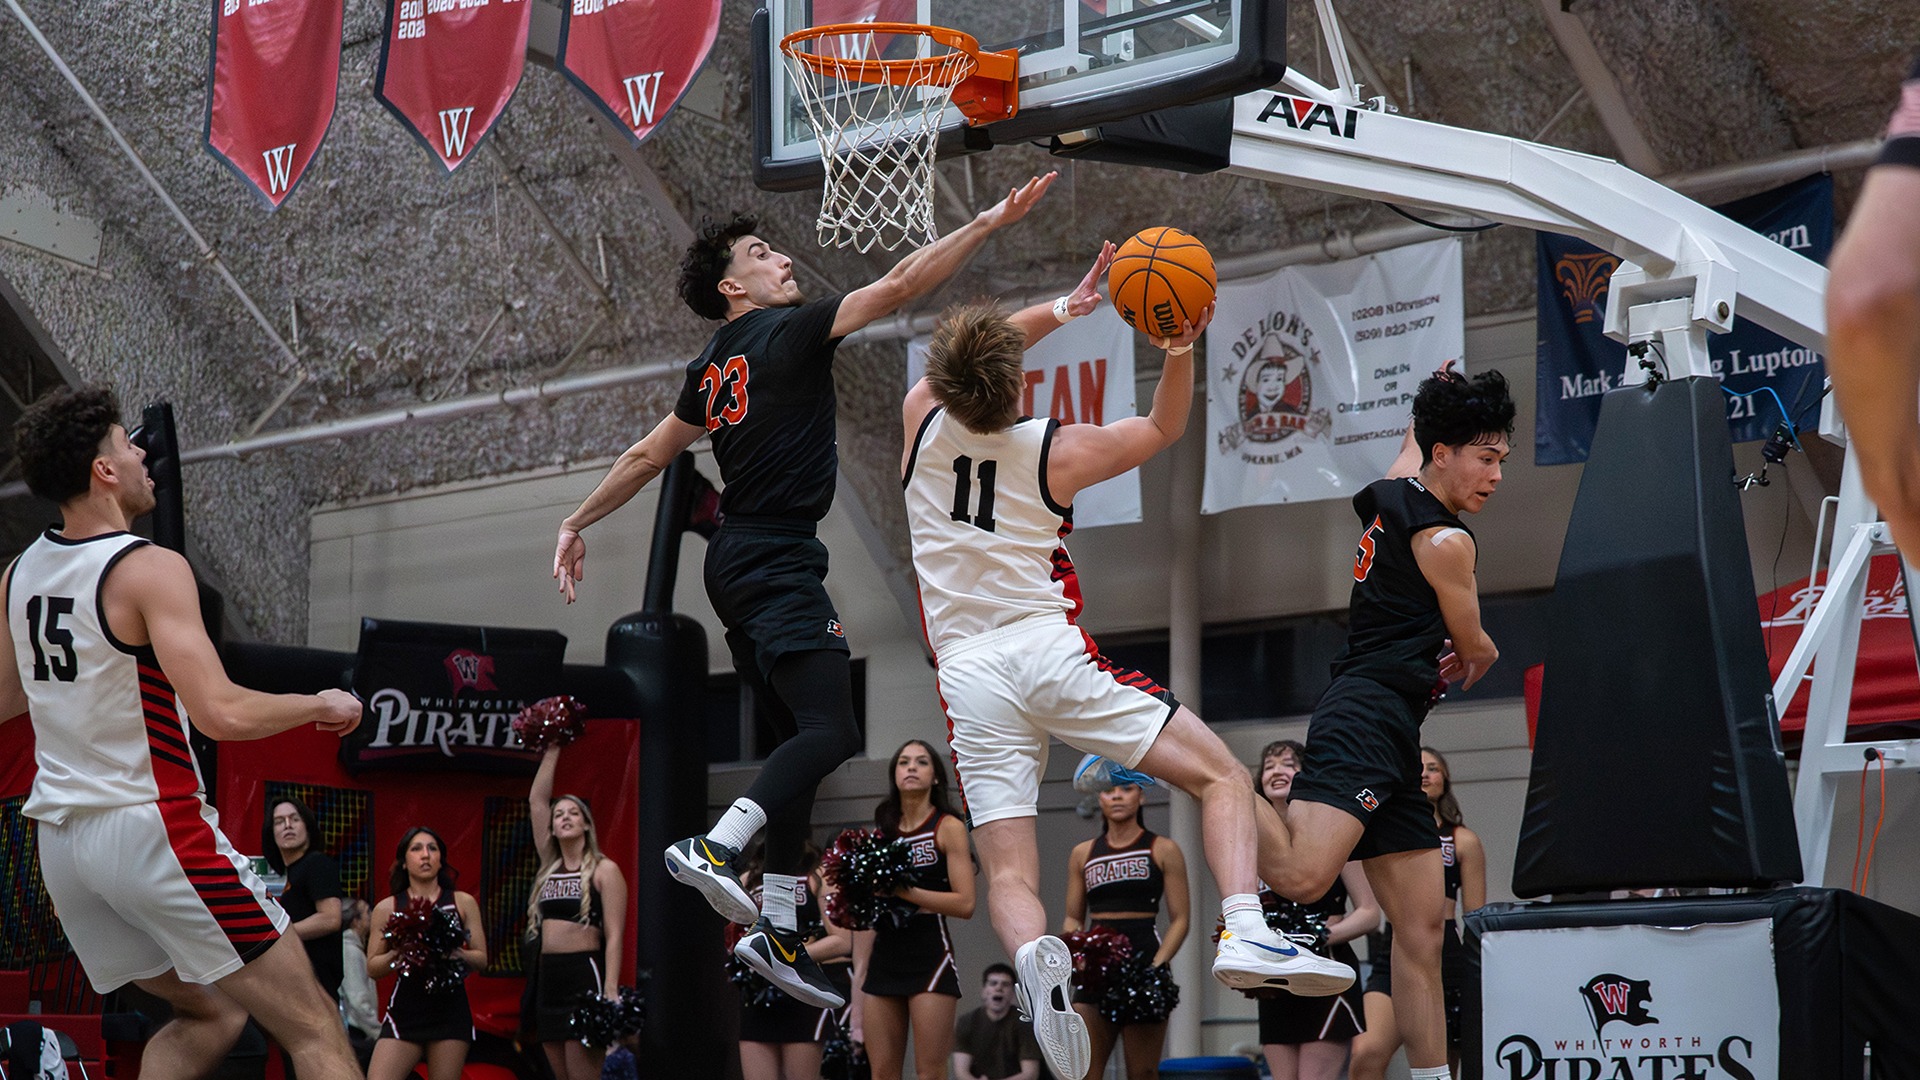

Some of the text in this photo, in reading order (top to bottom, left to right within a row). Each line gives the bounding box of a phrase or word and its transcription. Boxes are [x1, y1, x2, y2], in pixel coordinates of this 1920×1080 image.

[623, 71, 664, 127] W
[439, 106, 474, 157] W
[262, 143, 296, 194] W
[1258, 310, 1313, 346] LON'S
[698, 354, 749, 434] 23
[1560, 372, 1611, 400] Mark
[1729, 348, 1818, 377] Lupton
[950, 454, 997, 532] 11
[26, 595, 78, 682] 15
[453, 654, 480, 683] W
[368, 688, 526, 757] PIRATE
[1593, 981, 1630, 1015] W
[1554, 1036, 1701, 1051] WHITWORTH
